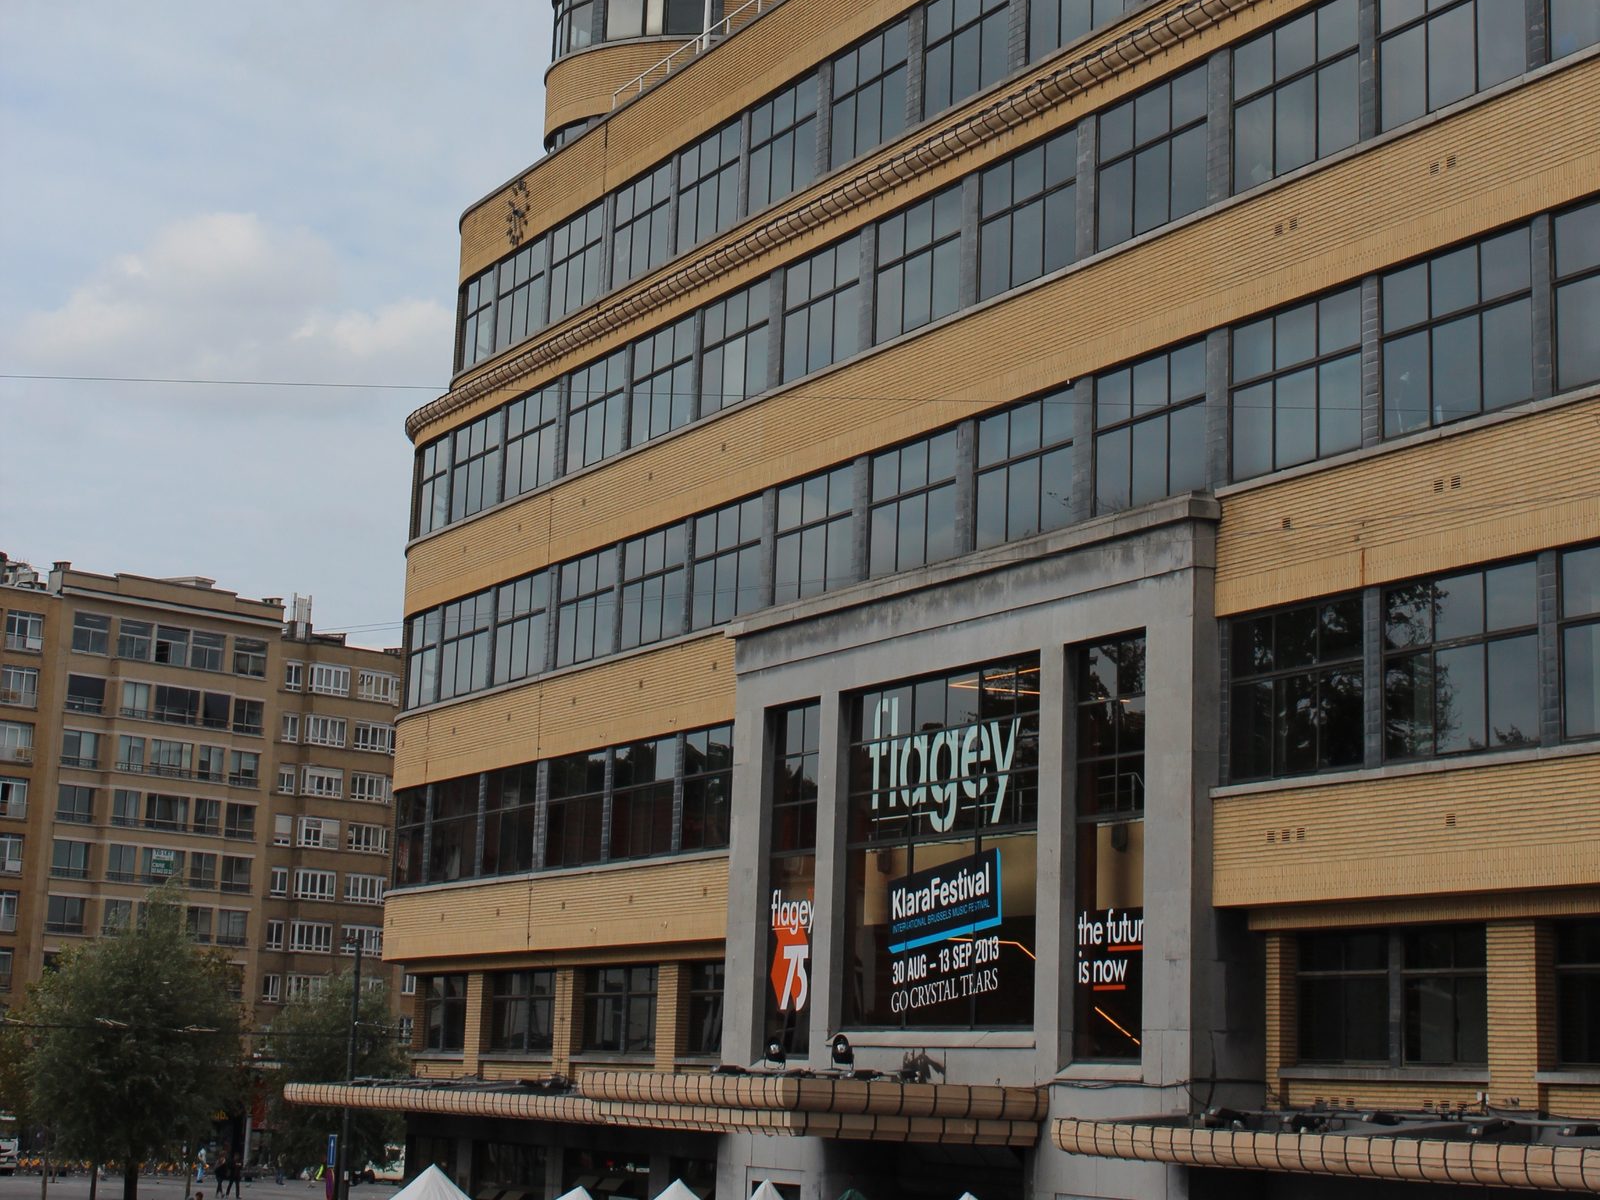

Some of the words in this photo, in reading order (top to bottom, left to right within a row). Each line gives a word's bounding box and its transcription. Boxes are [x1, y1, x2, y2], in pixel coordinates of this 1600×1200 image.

[869, 696, 1021, 832] flagey
[771, 889, 815, 935] flagey
[892, 861, 990, 920] KlaraFestival
[927, 909, 952, 925] BRUSSELS
[952, 903, 968, 919] MUSIC
[1078, 910, 1103, 945] the
[780, 944, 809, 1012] 75
[892, 960, 904, 985] 30
[907, 954, 927, 982] AUG
[939, 948, 950, 973] 13
[953, 942, 972, 970] SEP
[975, 935, 999, 964] 2013
[1078, 950, 1090, 984] is
[1093, 959, 1128, 983] now
[891, 990, 909, 1013] GO
[910, 978, 959, 1009] CRYSTAL
[960, 967, 998, 997] TEARS
